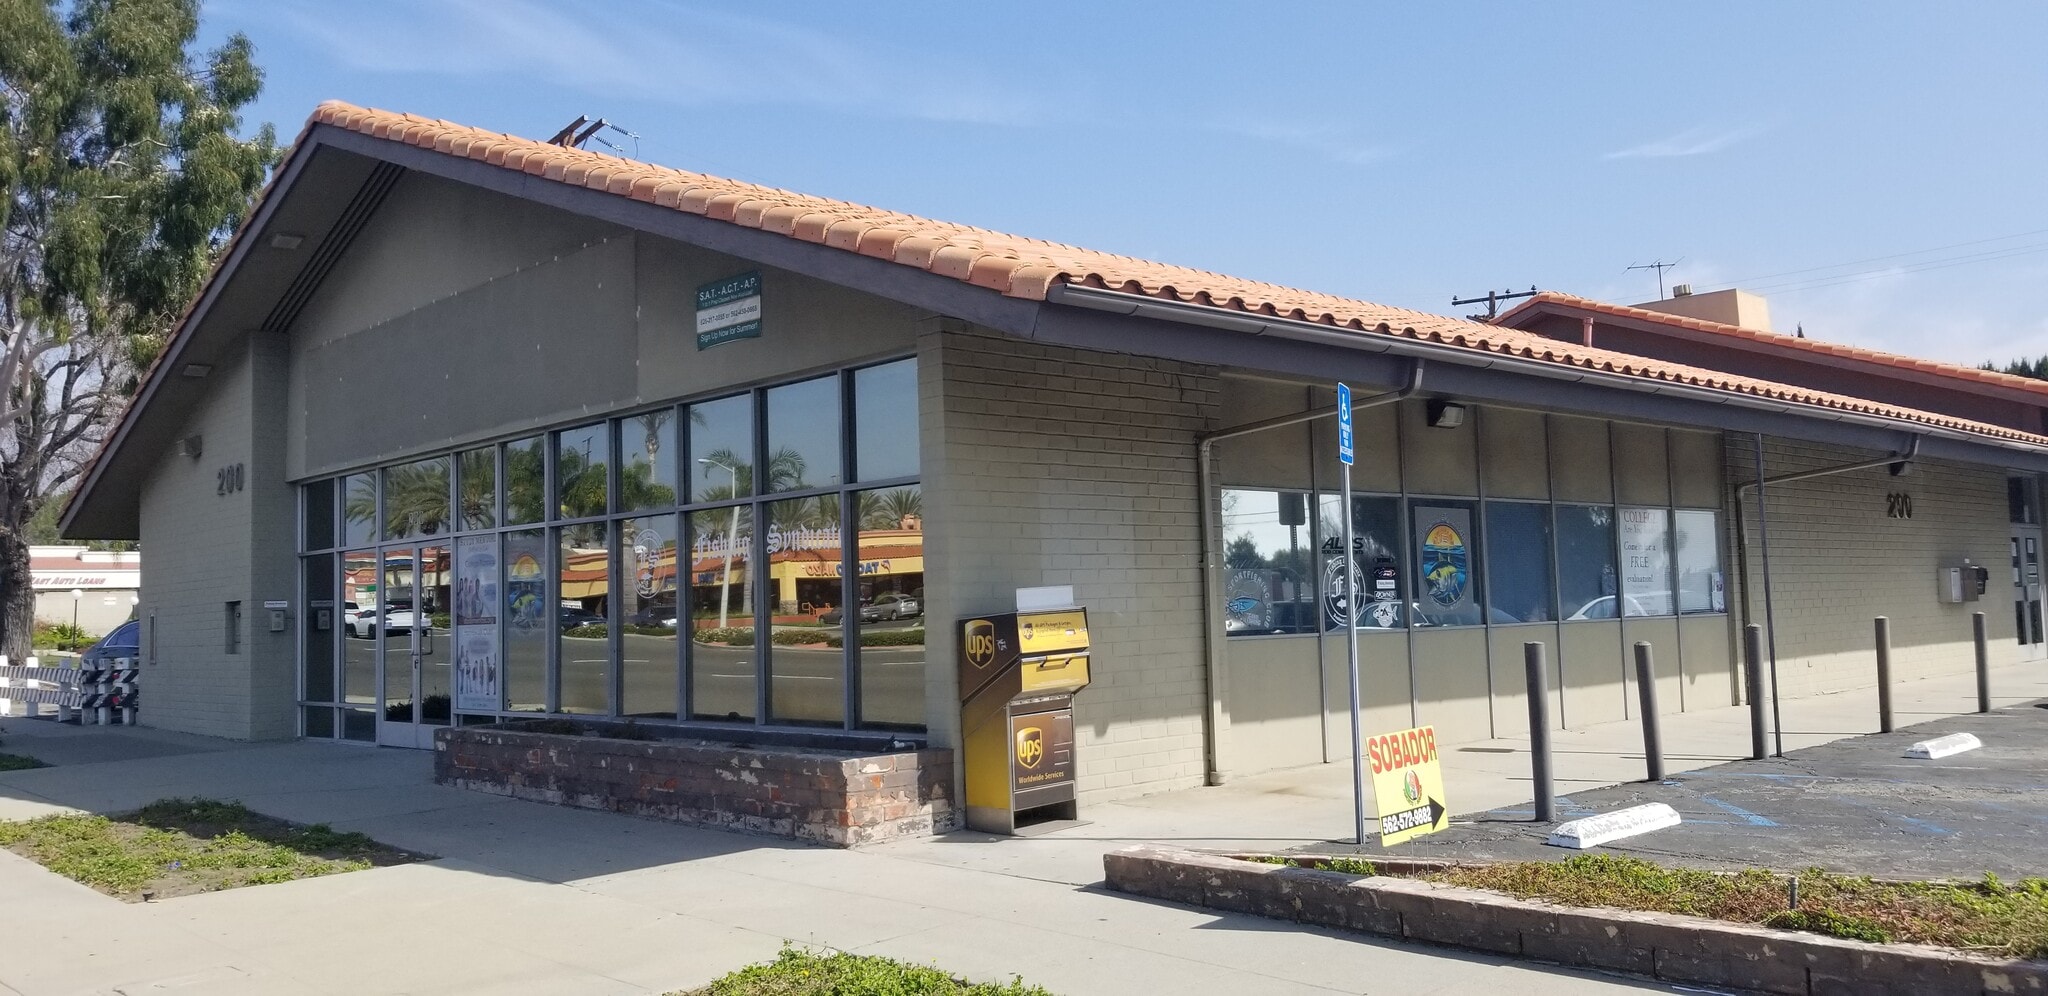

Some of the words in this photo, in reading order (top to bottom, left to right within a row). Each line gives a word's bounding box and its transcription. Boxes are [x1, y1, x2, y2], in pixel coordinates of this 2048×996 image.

[216, 462, 245, 496] 200
[1886, 493, 1912, 519] 200
[766, 523, 842, 557] Syndicat
[1321, 536, 1364, 550] ALS
[1630, 556, 1650, 568] FREE
[968, 634, 993, 662] ups
[1019, 738, 1041, 763] ups
[1368, 727, 1438, 775] SOBADOR
[1018, 773, 1044, 784] Worldwide
[1044, 770, 1065, 780] Services
